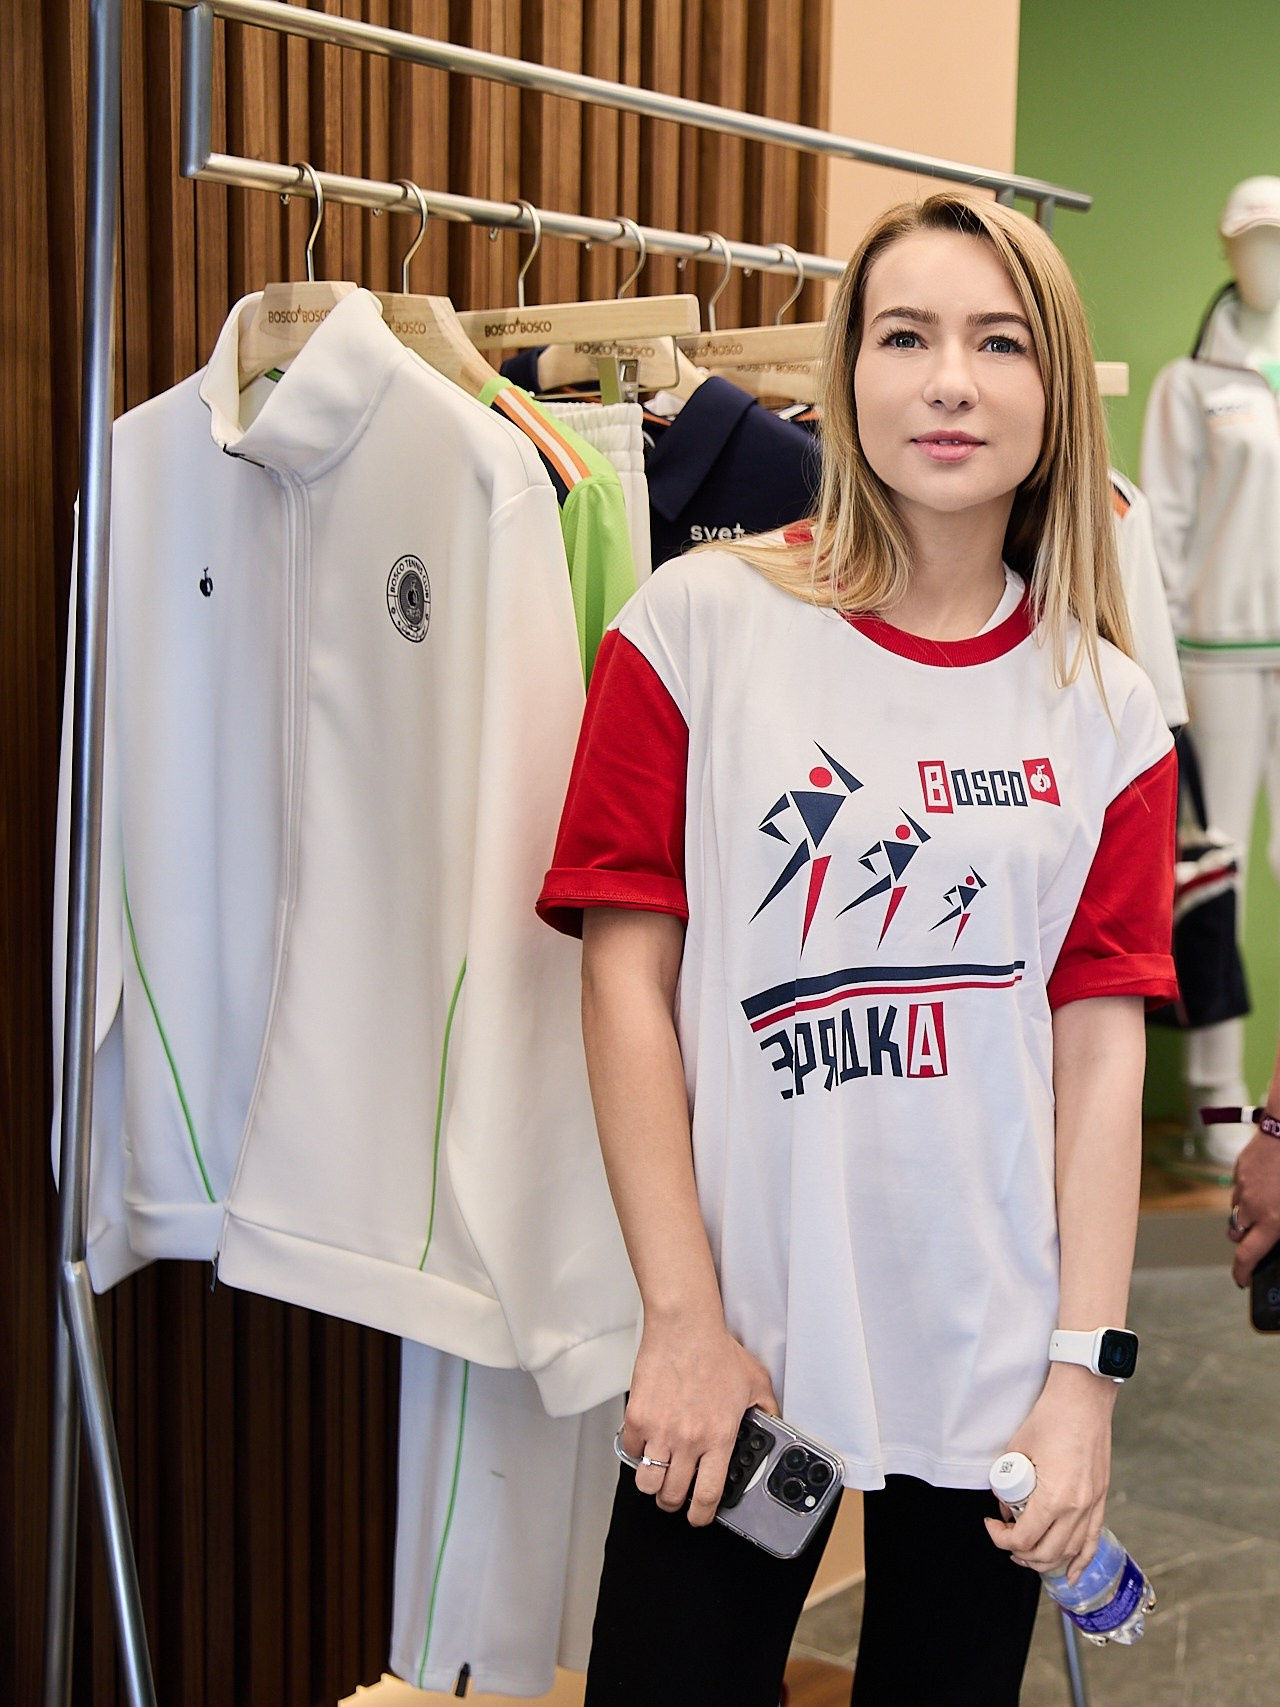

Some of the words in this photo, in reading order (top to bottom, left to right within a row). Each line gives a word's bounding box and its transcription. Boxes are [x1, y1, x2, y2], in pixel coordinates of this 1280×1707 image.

[268, 310, 298, 323] BOSCO
[395, 321, 427, 335] BOSCO
[485, 323, 516, 337] BOSCO
[520, 321, 552, 334] BOSCO
[684, 345, 708, 359] OSCO
[390, 562, 405, 593] BOSCO
[404, 558, 423, 575] TENNIS
